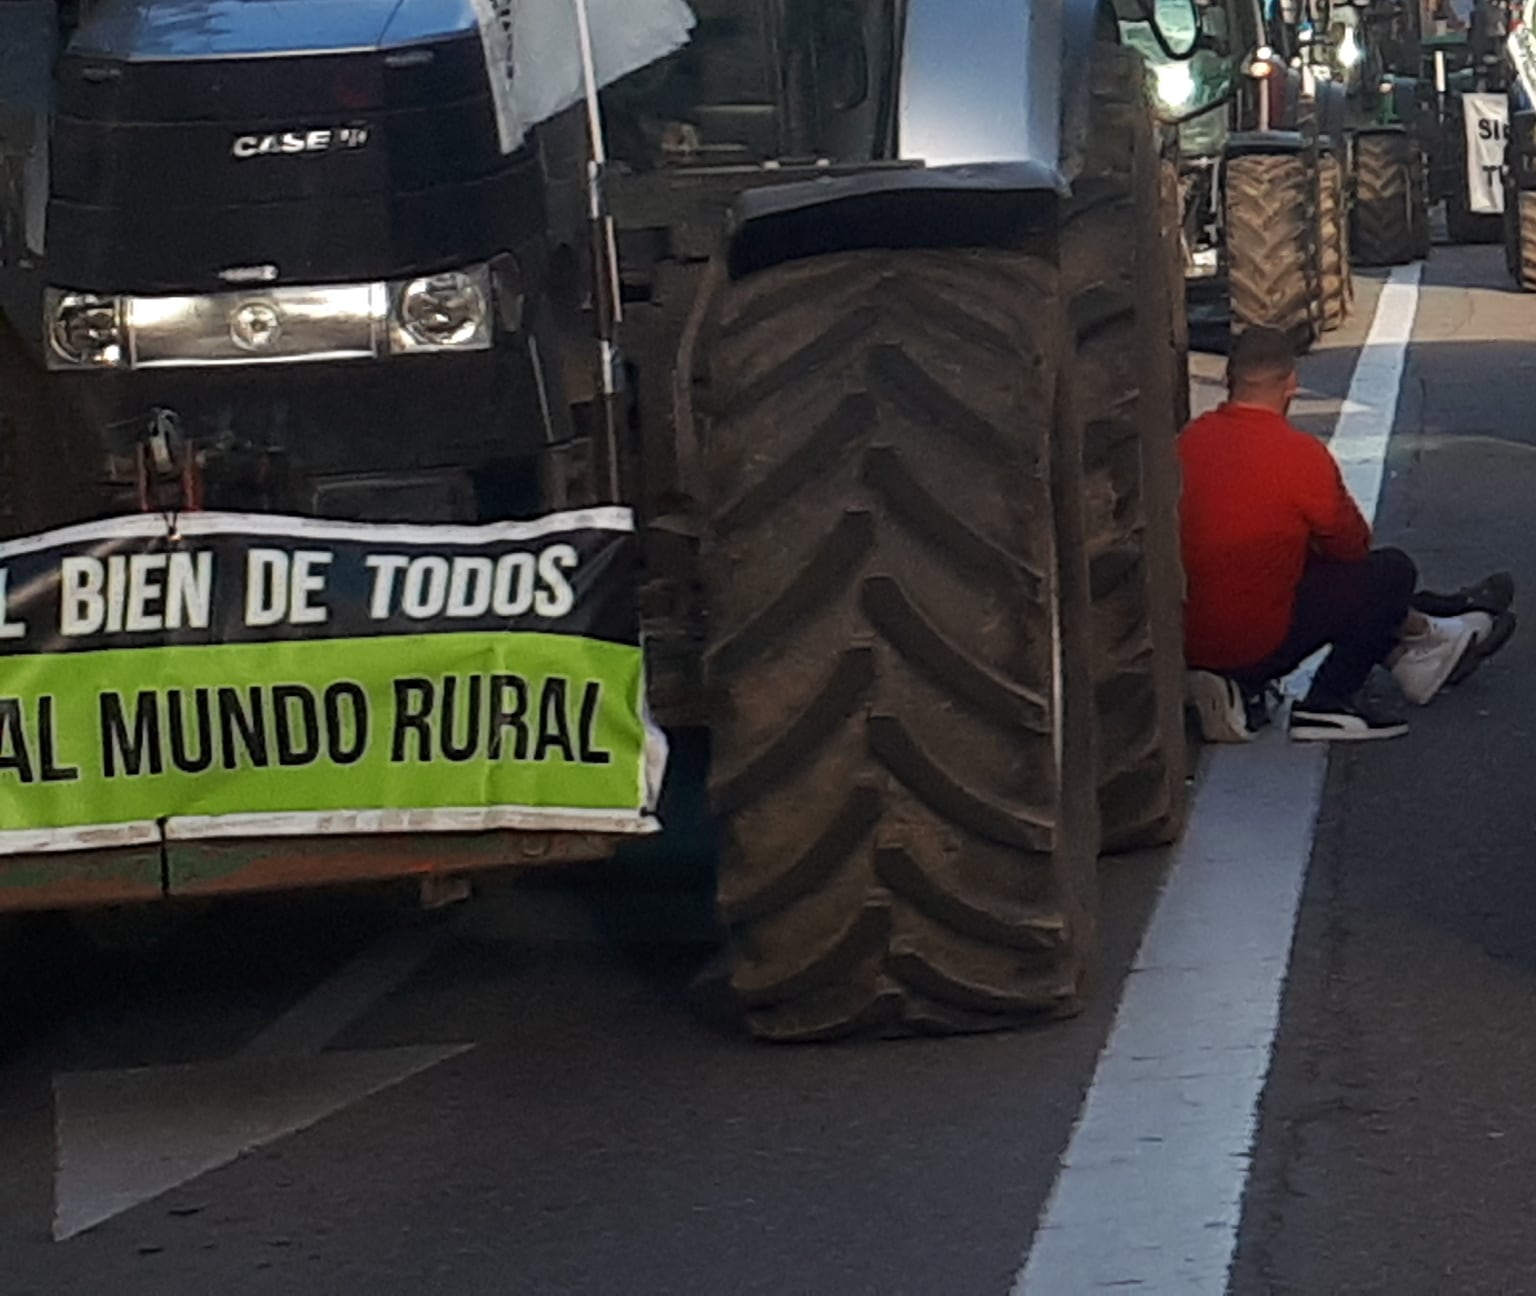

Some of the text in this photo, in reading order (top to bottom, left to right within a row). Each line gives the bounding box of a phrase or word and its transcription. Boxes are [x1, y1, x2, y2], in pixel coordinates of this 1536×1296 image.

[233, 129, 331, 157] CASE
[0, 542, 579, 640] L BIEN DE TODOS
[0, 674, 611, 784] AL MUNDO RURAL
